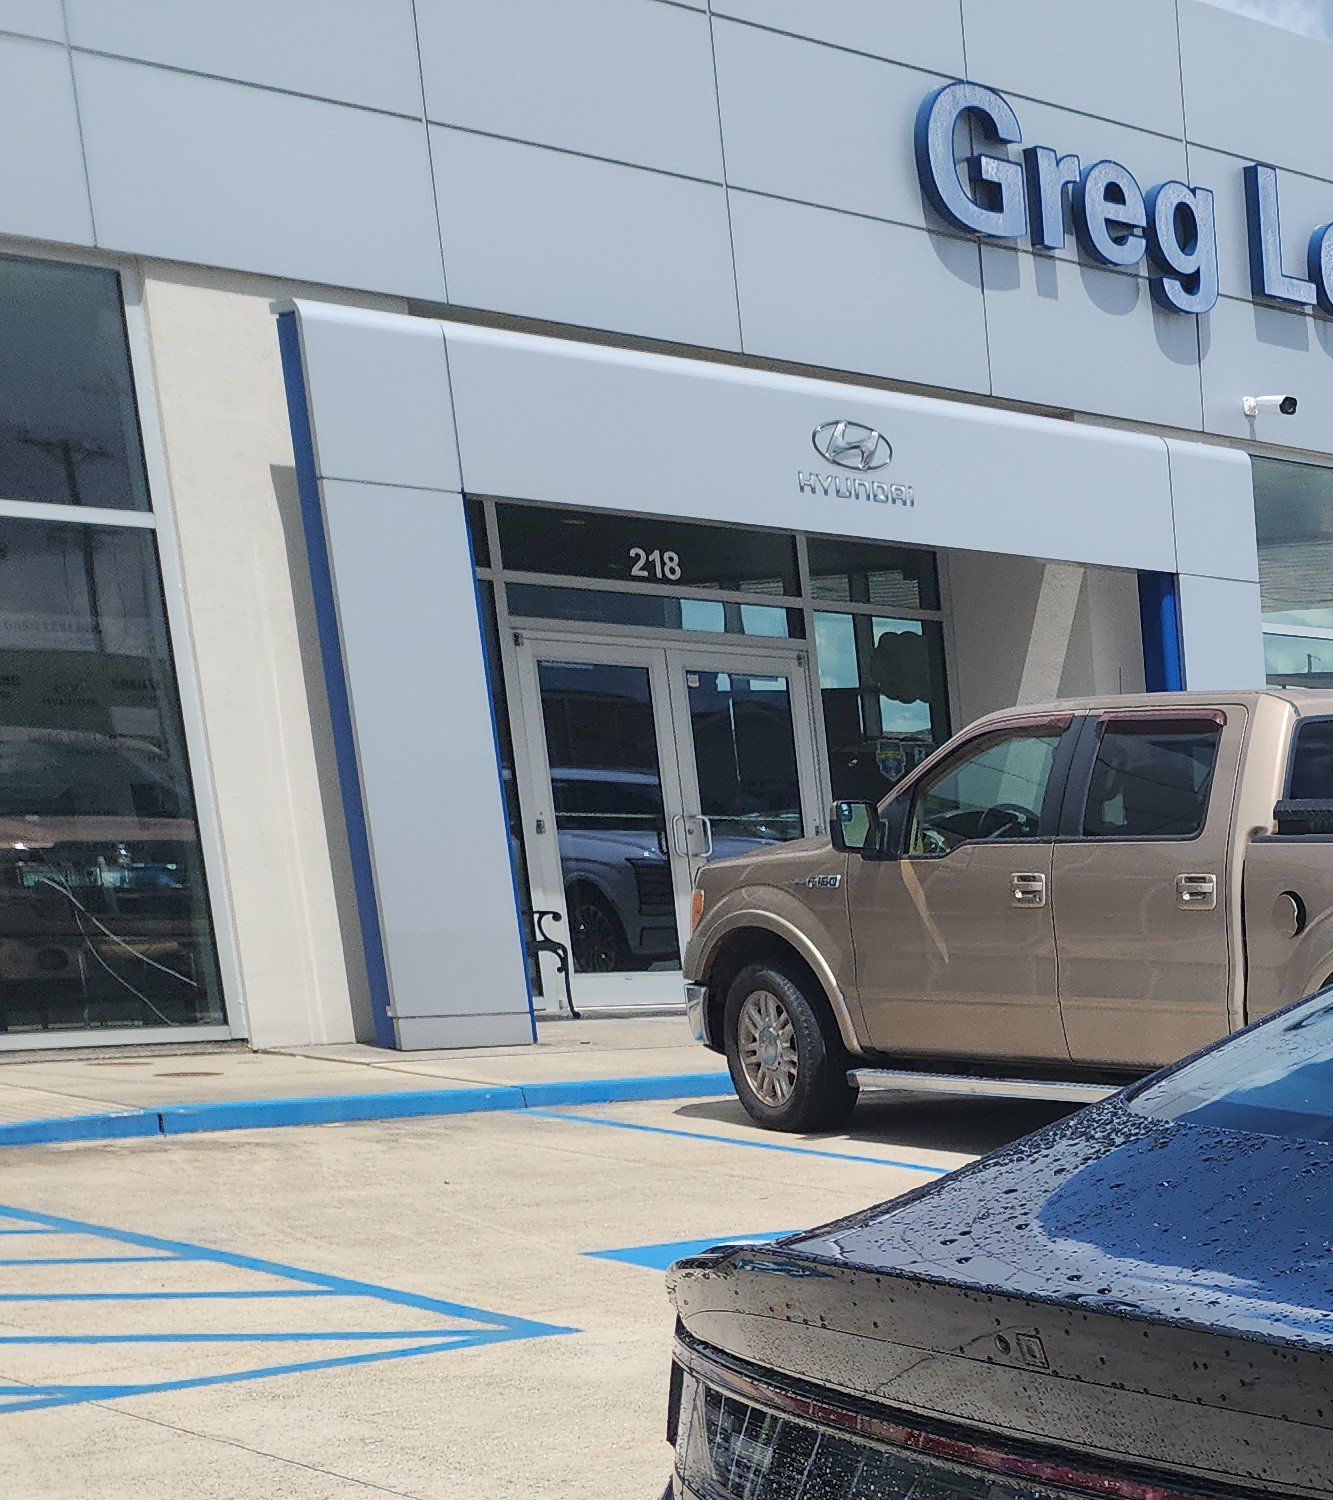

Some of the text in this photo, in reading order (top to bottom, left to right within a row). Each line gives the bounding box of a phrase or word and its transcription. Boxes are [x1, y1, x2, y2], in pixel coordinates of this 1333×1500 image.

[914, 81, 1218, 315] Greg
[798, 470, 915, 507] HYUNDAI
[629, 547, 682, 582] 218
